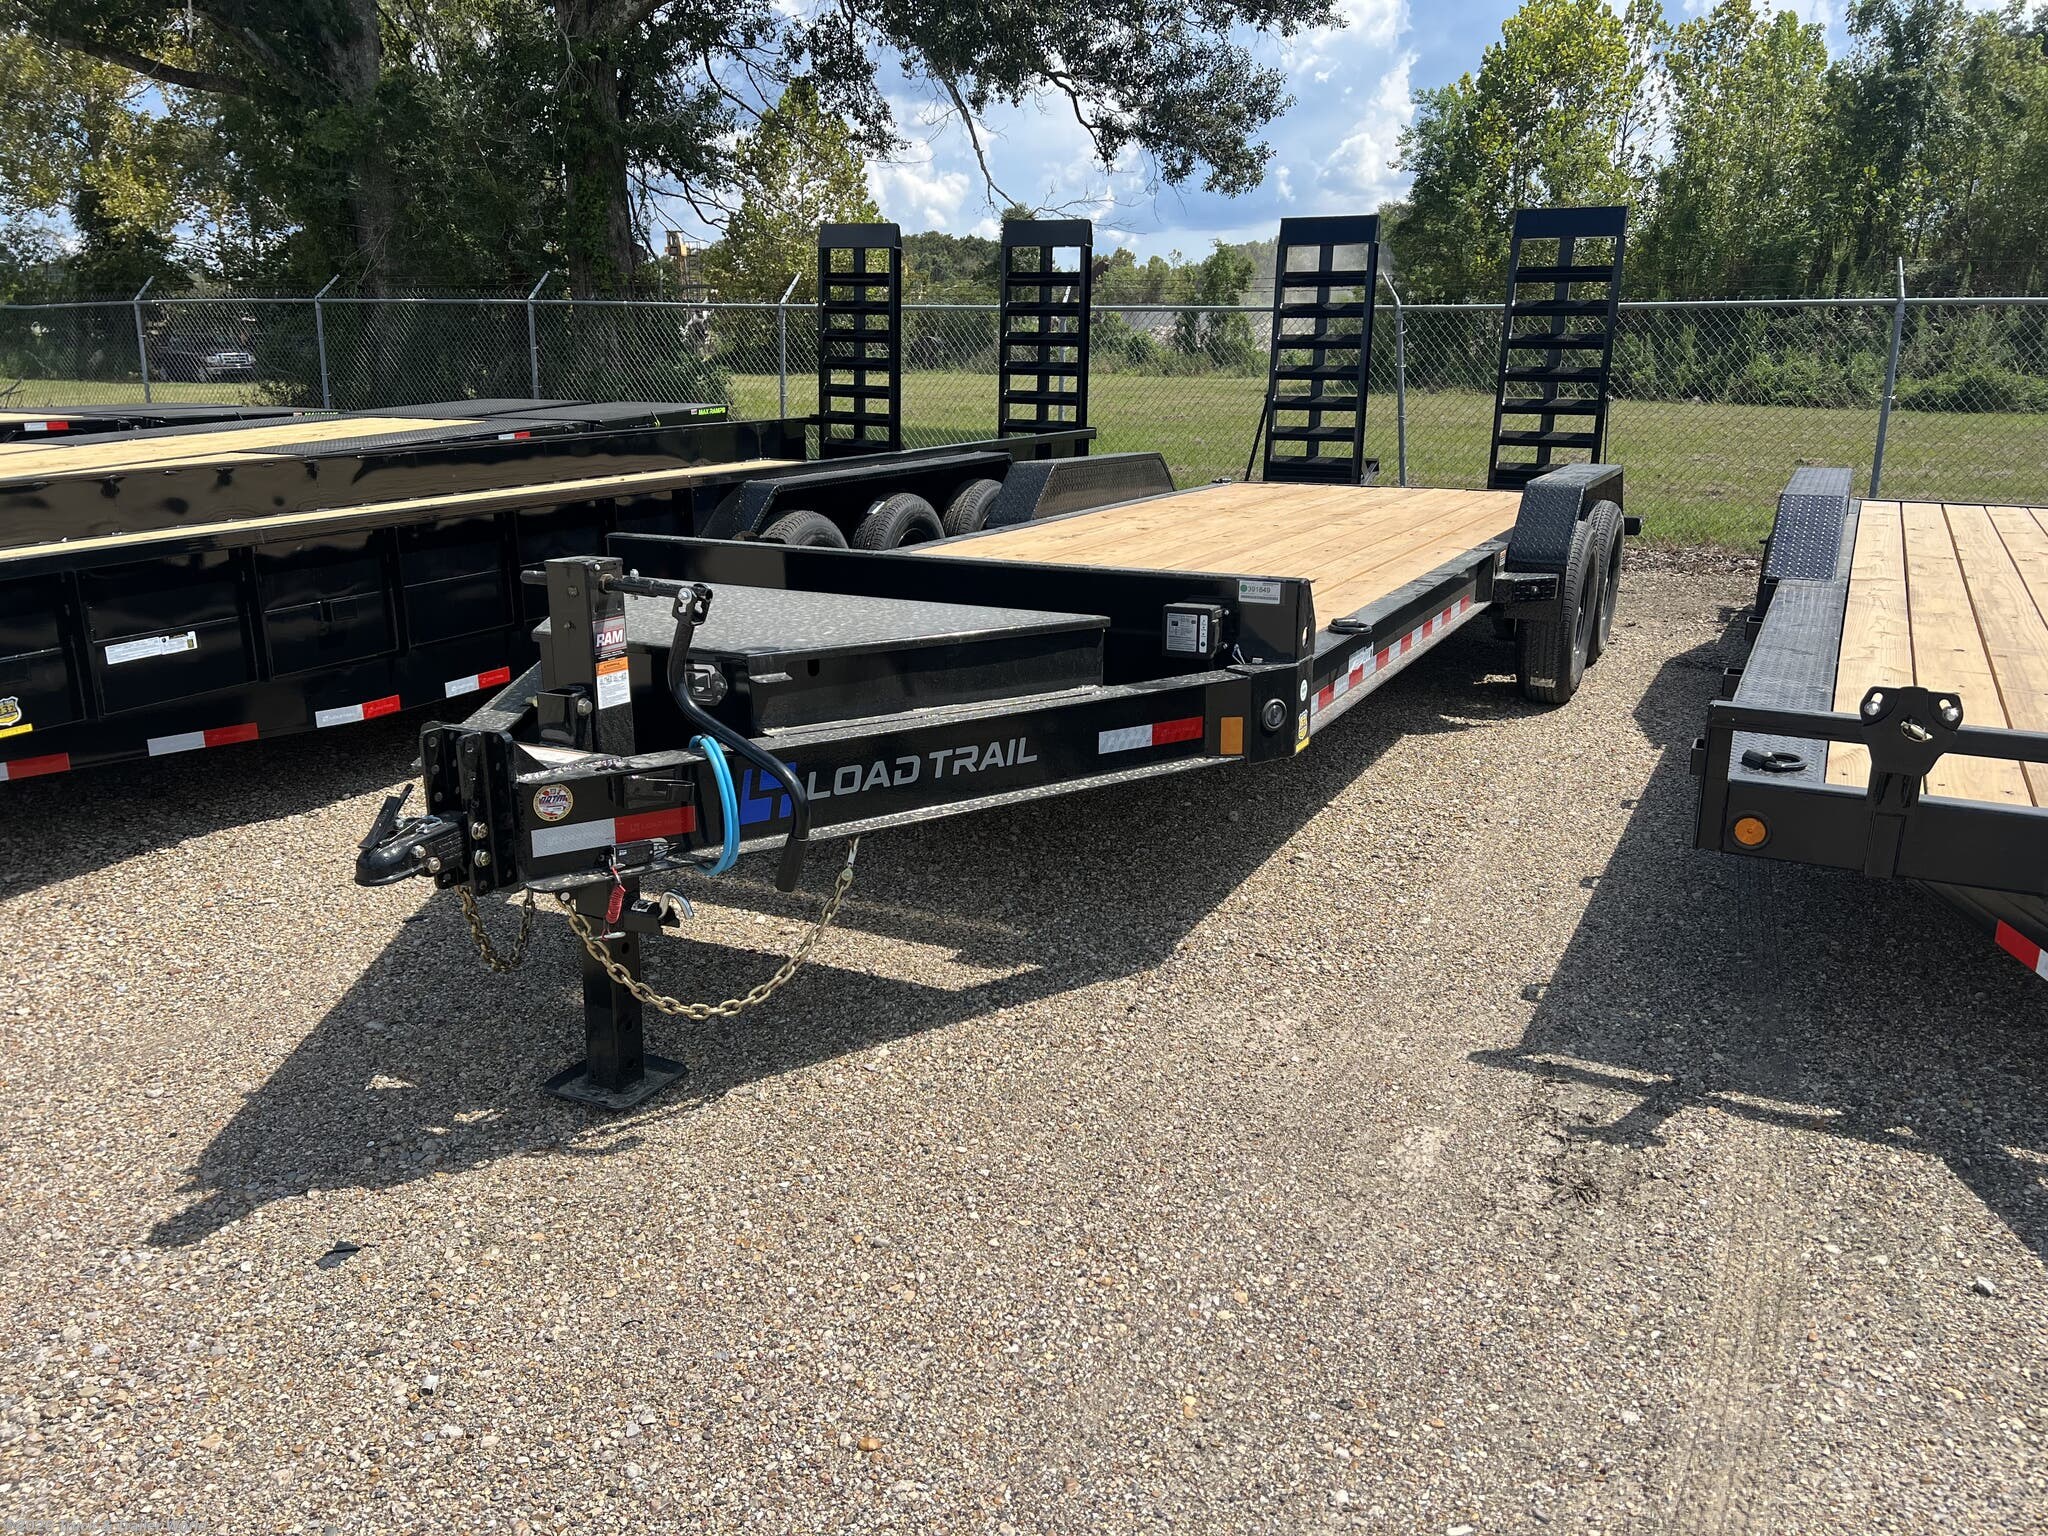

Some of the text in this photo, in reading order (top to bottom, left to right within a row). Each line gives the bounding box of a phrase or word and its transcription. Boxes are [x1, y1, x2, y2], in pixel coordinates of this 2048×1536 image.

[596, 628, 624, 648] RAM
[807, 755, 920, 800] LOAD
[929, 737, 1038, 779] TRAIL
